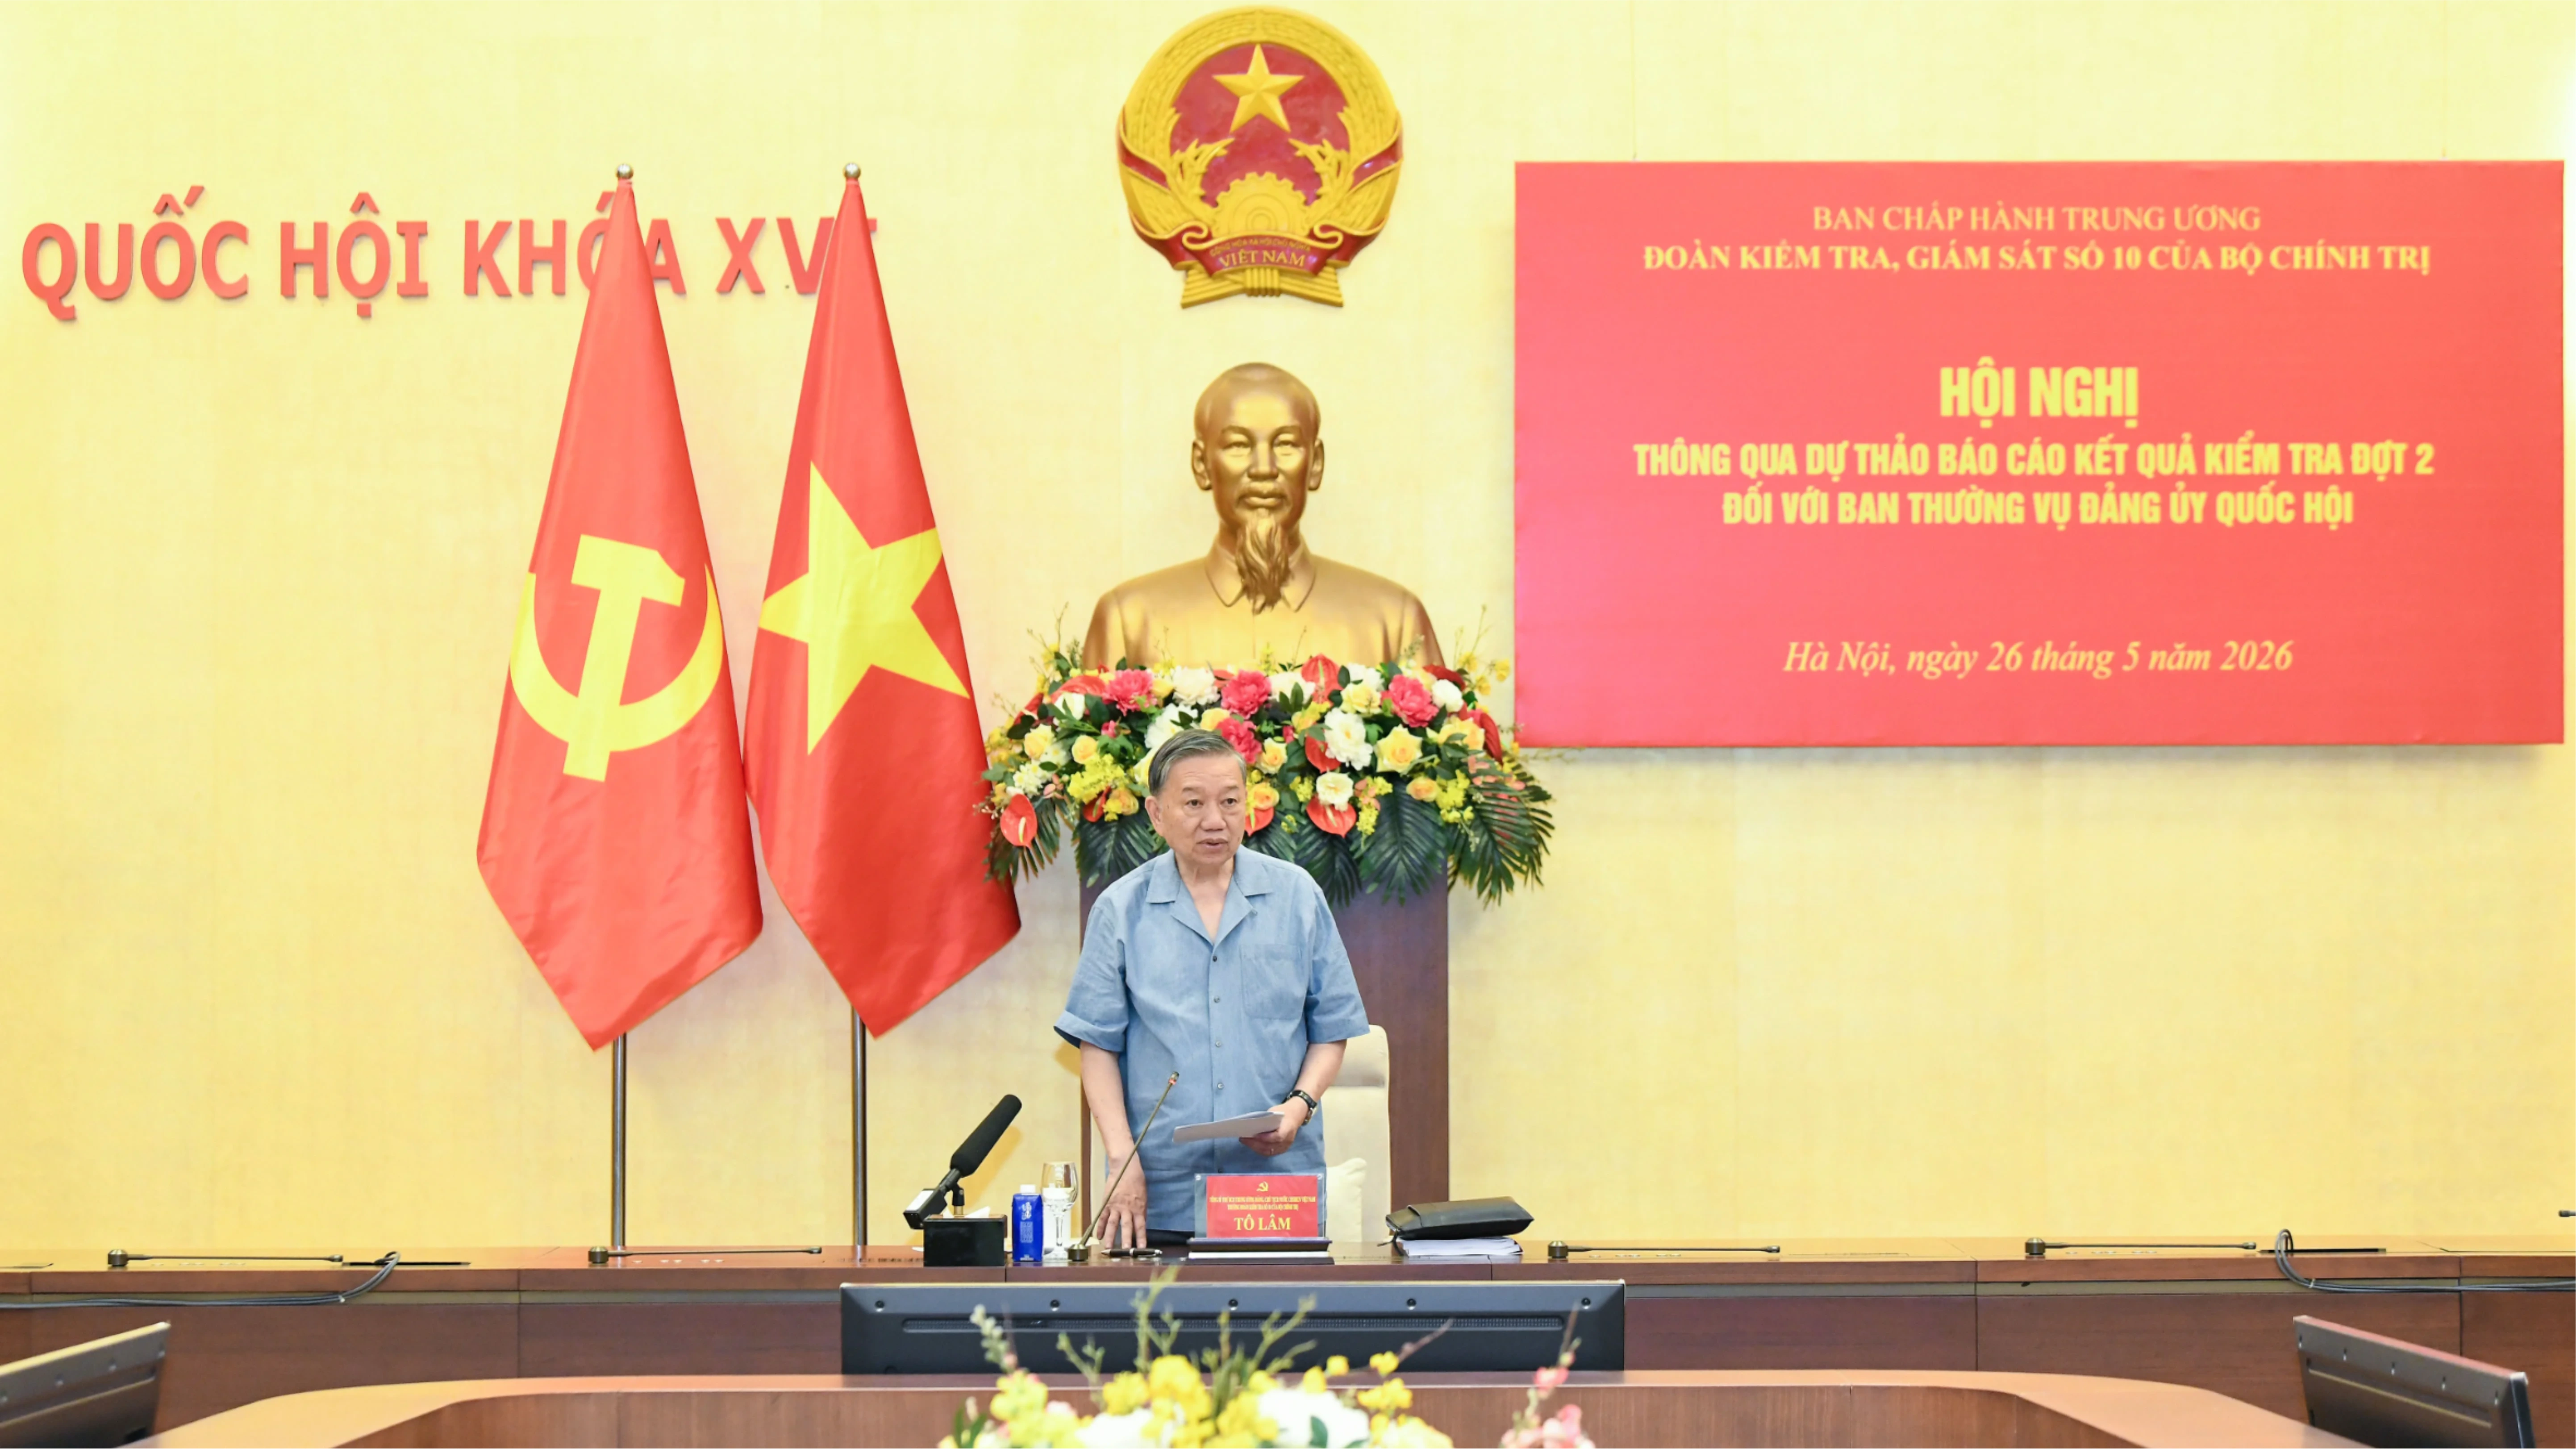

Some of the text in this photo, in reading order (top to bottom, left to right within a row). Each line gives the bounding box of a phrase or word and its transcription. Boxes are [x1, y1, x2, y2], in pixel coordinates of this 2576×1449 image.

[1813, 206, 1874, 230] BAN
[1971, 200, 2054, 231] HÀNH
[2062, 207, 2165, 231] TRUNG
[2174, 204, 2261, 231] ƯƠNG
[22, 186, 248, 321] QUỐC
[280, 192, 429, 317] HỘI
[715, 217, 877, 295] XV
[1262, 250, 1306, 267] NAM
[1643, 239, 1730, 270] ĐOÀN
[1828, 246, 1900, 272] TRA,
[1906, 238, 1991, 270] GIÁM
[1999, 238, 2057, 270] SÁT
[2113, 246, 2142, 270] 10
[2148, 239, 2213, 270] CỦA
[2220, 242, 2263, 276] BỘ
[2269, 238, 2370, 270] CHÍNH
[2377, 246, 2430, 276] TRỊ
[1940, 356, 2138, 429] HỘI NGHỊ
[1633, 430, 2434, 482] THÔNG QUA DỰ THẢO BÁO CÁO KẾT QUẢ KIỂM TRA ĐỢT 2
[1722, 480, 2354, 531] ĐỐI VỚI BAN THƯỜNG VỤ ĐẢNG ỦY QUỐC HỘI
[1783, 640, 2293, 679] Hà Nội, ngày 26 tháng 5 năm 2026
[1234, 1213, 1291, 1231] TÔ LÂM
